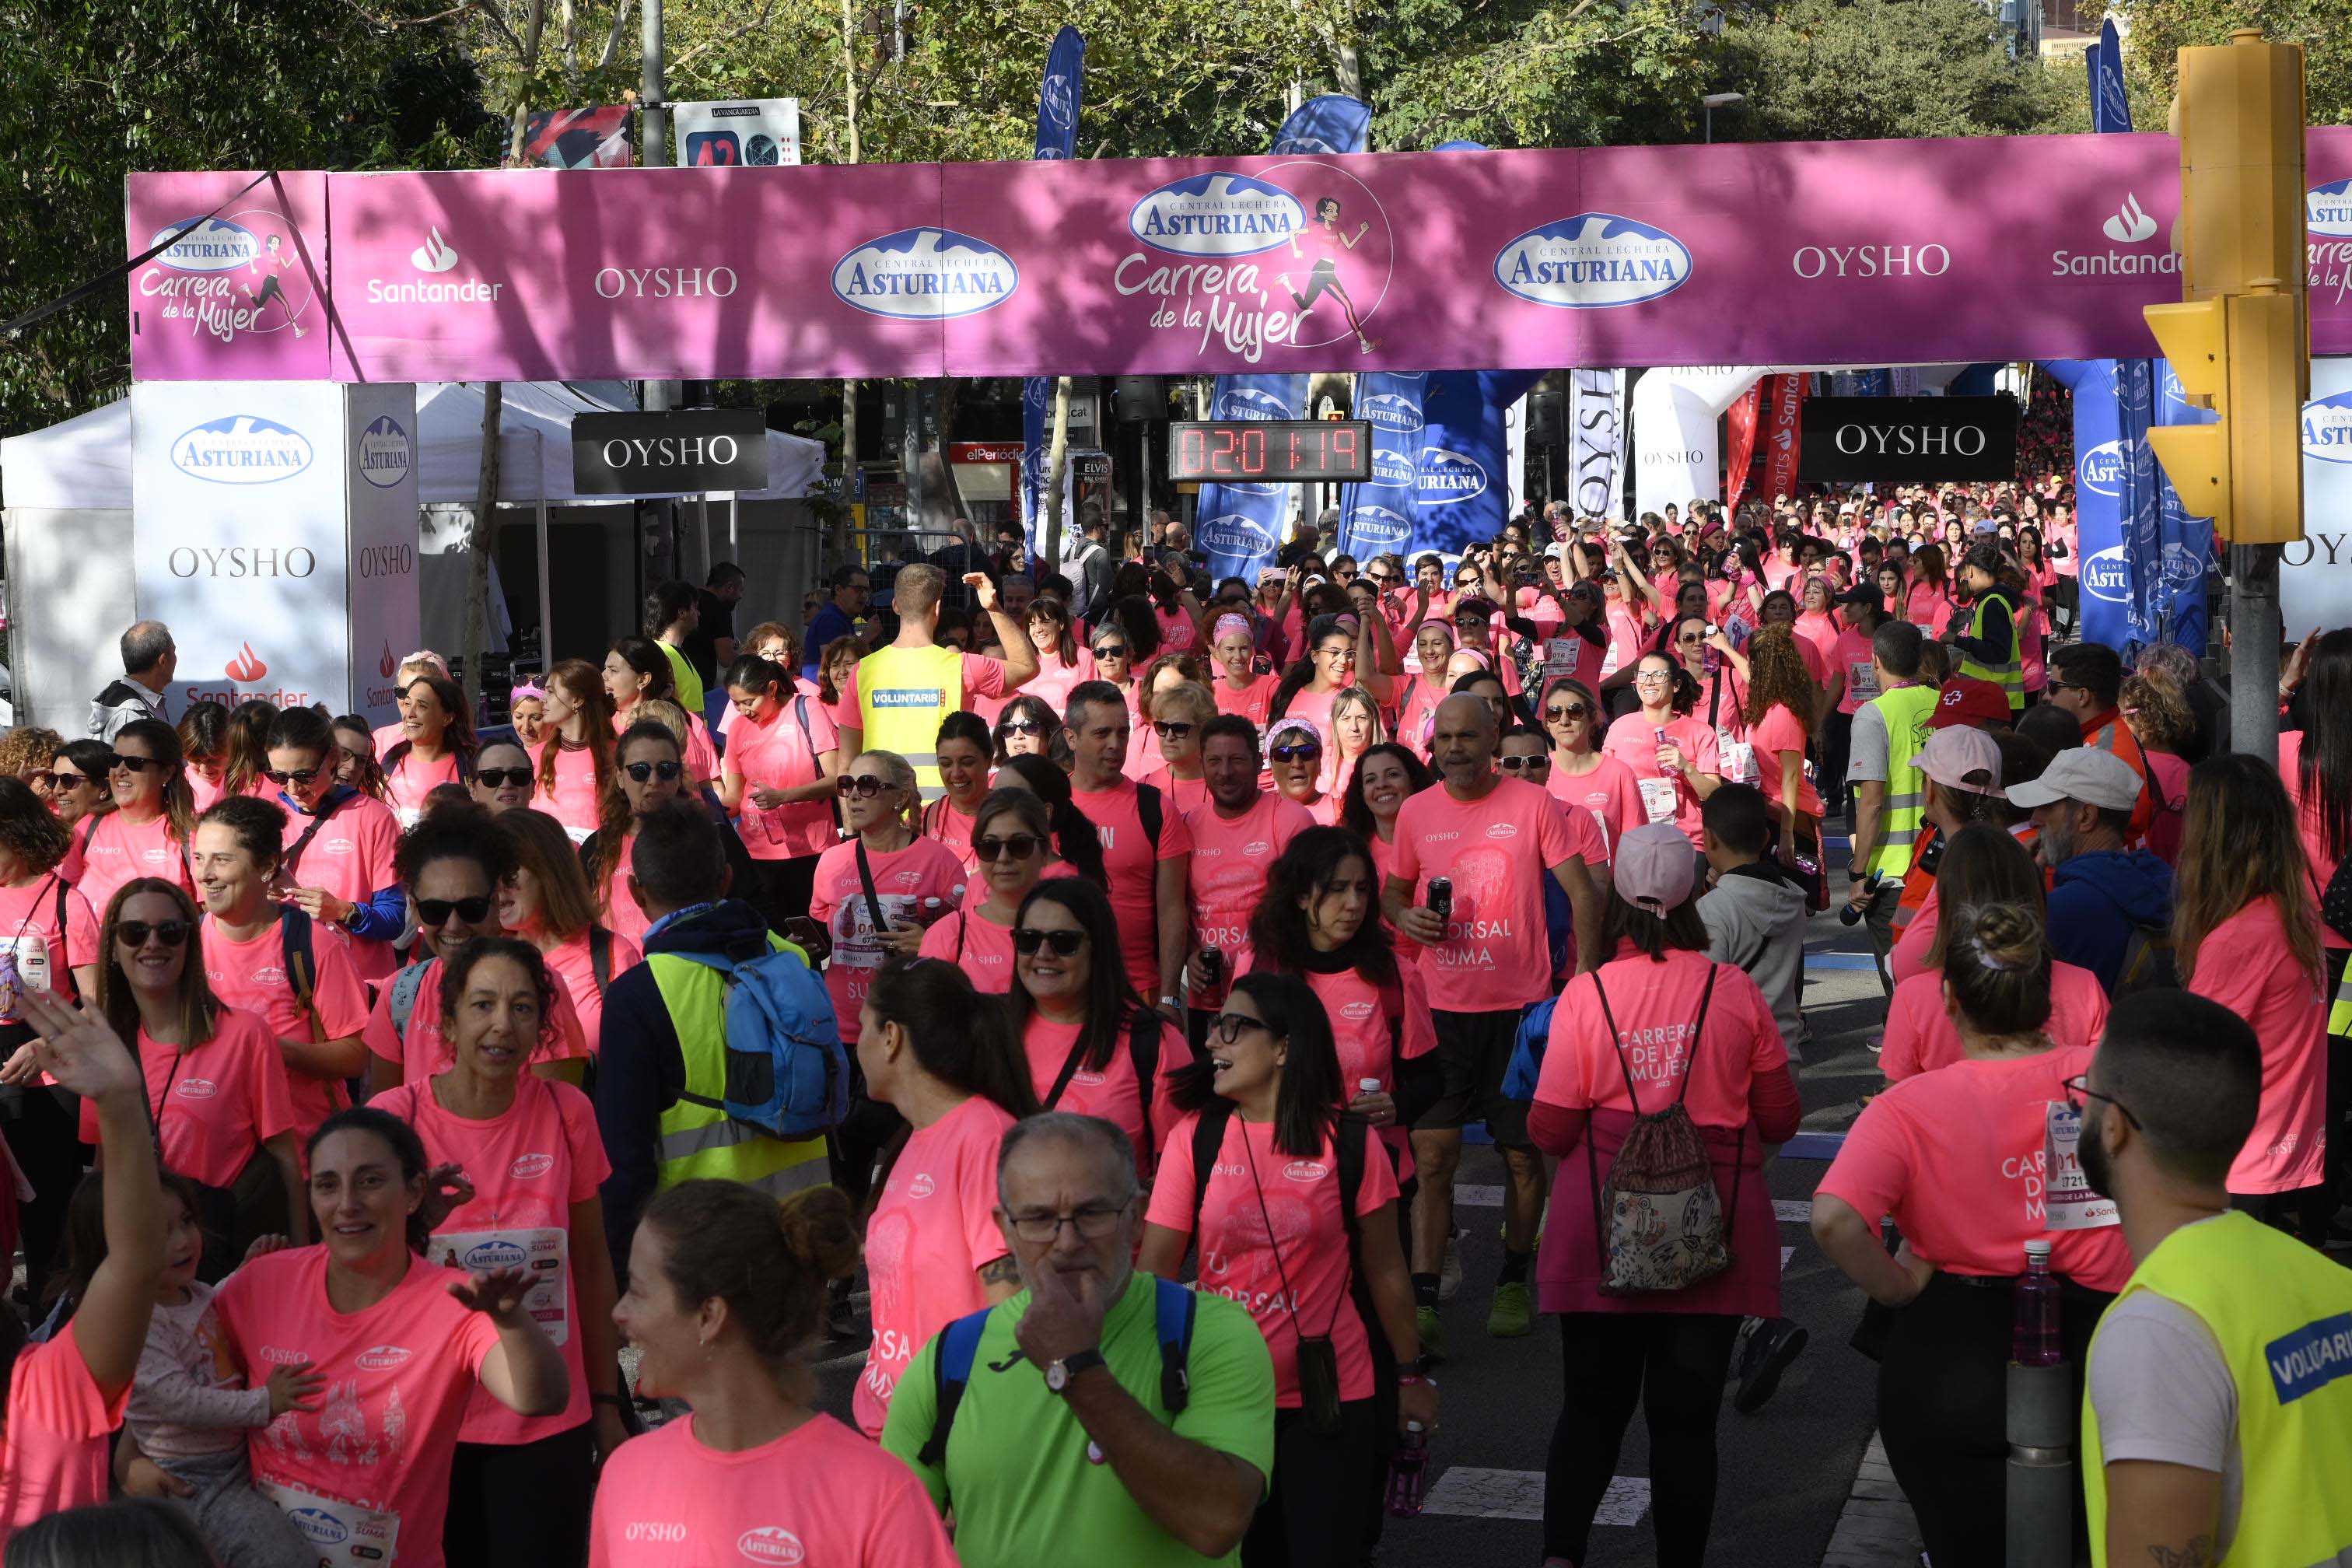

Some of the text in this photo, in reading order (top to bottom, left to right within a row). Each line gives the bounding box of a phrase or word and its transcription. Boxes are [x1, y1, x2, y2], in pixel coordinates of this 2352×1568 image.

[720, 107, 759, 117] VANGUARDIA
[1170, 200, 1287, 211] CENTRAL LECHERA
[1143, 205, 1292, 236] ASTURIANA
[874, 257, 997, 268] CENTRAL LECHERA
[1540, 245, 1670, 256] CENTRAL LECHERA
[1792, 243, 1951, 278] OYSHO
[845, 261, 1004, 296] ASTURIANA
[1115, 252, 1259, 296] Carrera
[1509, 250, 1677, 285] ASTURIANA
[2325, 264, 2339, 286] la
[139, 268, 231, 296] Carrera
[368, 278, 502, 304] Santander
[594, 267, 737, 298] OYSHO
[162, 295, 265, 342] de la Mujer
[1150, 291, 1314, 363] de la Mujer
[1779, 373, 1799, 425] Santa
[1361, 404, 1419, 429] ASTURIANA
[603, 435, 739, 467] OYSHO
[1181, 429, 1356, 473] 02:01:19
[1836, 424, 1986, 456] OYSHO
[182, 441, 303, 467] ASTURIANA
[362, 443, 408, 471] ASTURIANA
[1644, 450, 1703, 466] OYSHO
[1084, 463, 1108, 473] ELVIS
[1205, 527, 1267, 552] ASTURIANA
[2279, 534, 2352, 566] OY
[169, 547, 316, 578] OYSHO
[360, 544, 411, 578] OYSHO
[873, 693, 938, 704] VOLUNTARIS
[1426, 831, 1459, 842] OYSHO
[1447, 919, 1512, 940] ORSAL
[1436, 947, 1493, 965] SUMA
[1617, 1021, 1697, 1048] CARRERA
[1633, 1042, 1684, 1063] DE LA
[1631, 1059, 1689, 1082] MUJER
[1286, 1167, 1324, 1177] ASTURIANA
[469, 1252, 523, 1265] ASTURIANA
[530, 1244, 558, 1253] SUMA
[625, 1521, 687, 1543] OYSHO
[744, 1535, 798, 1559] ASTURIANA
